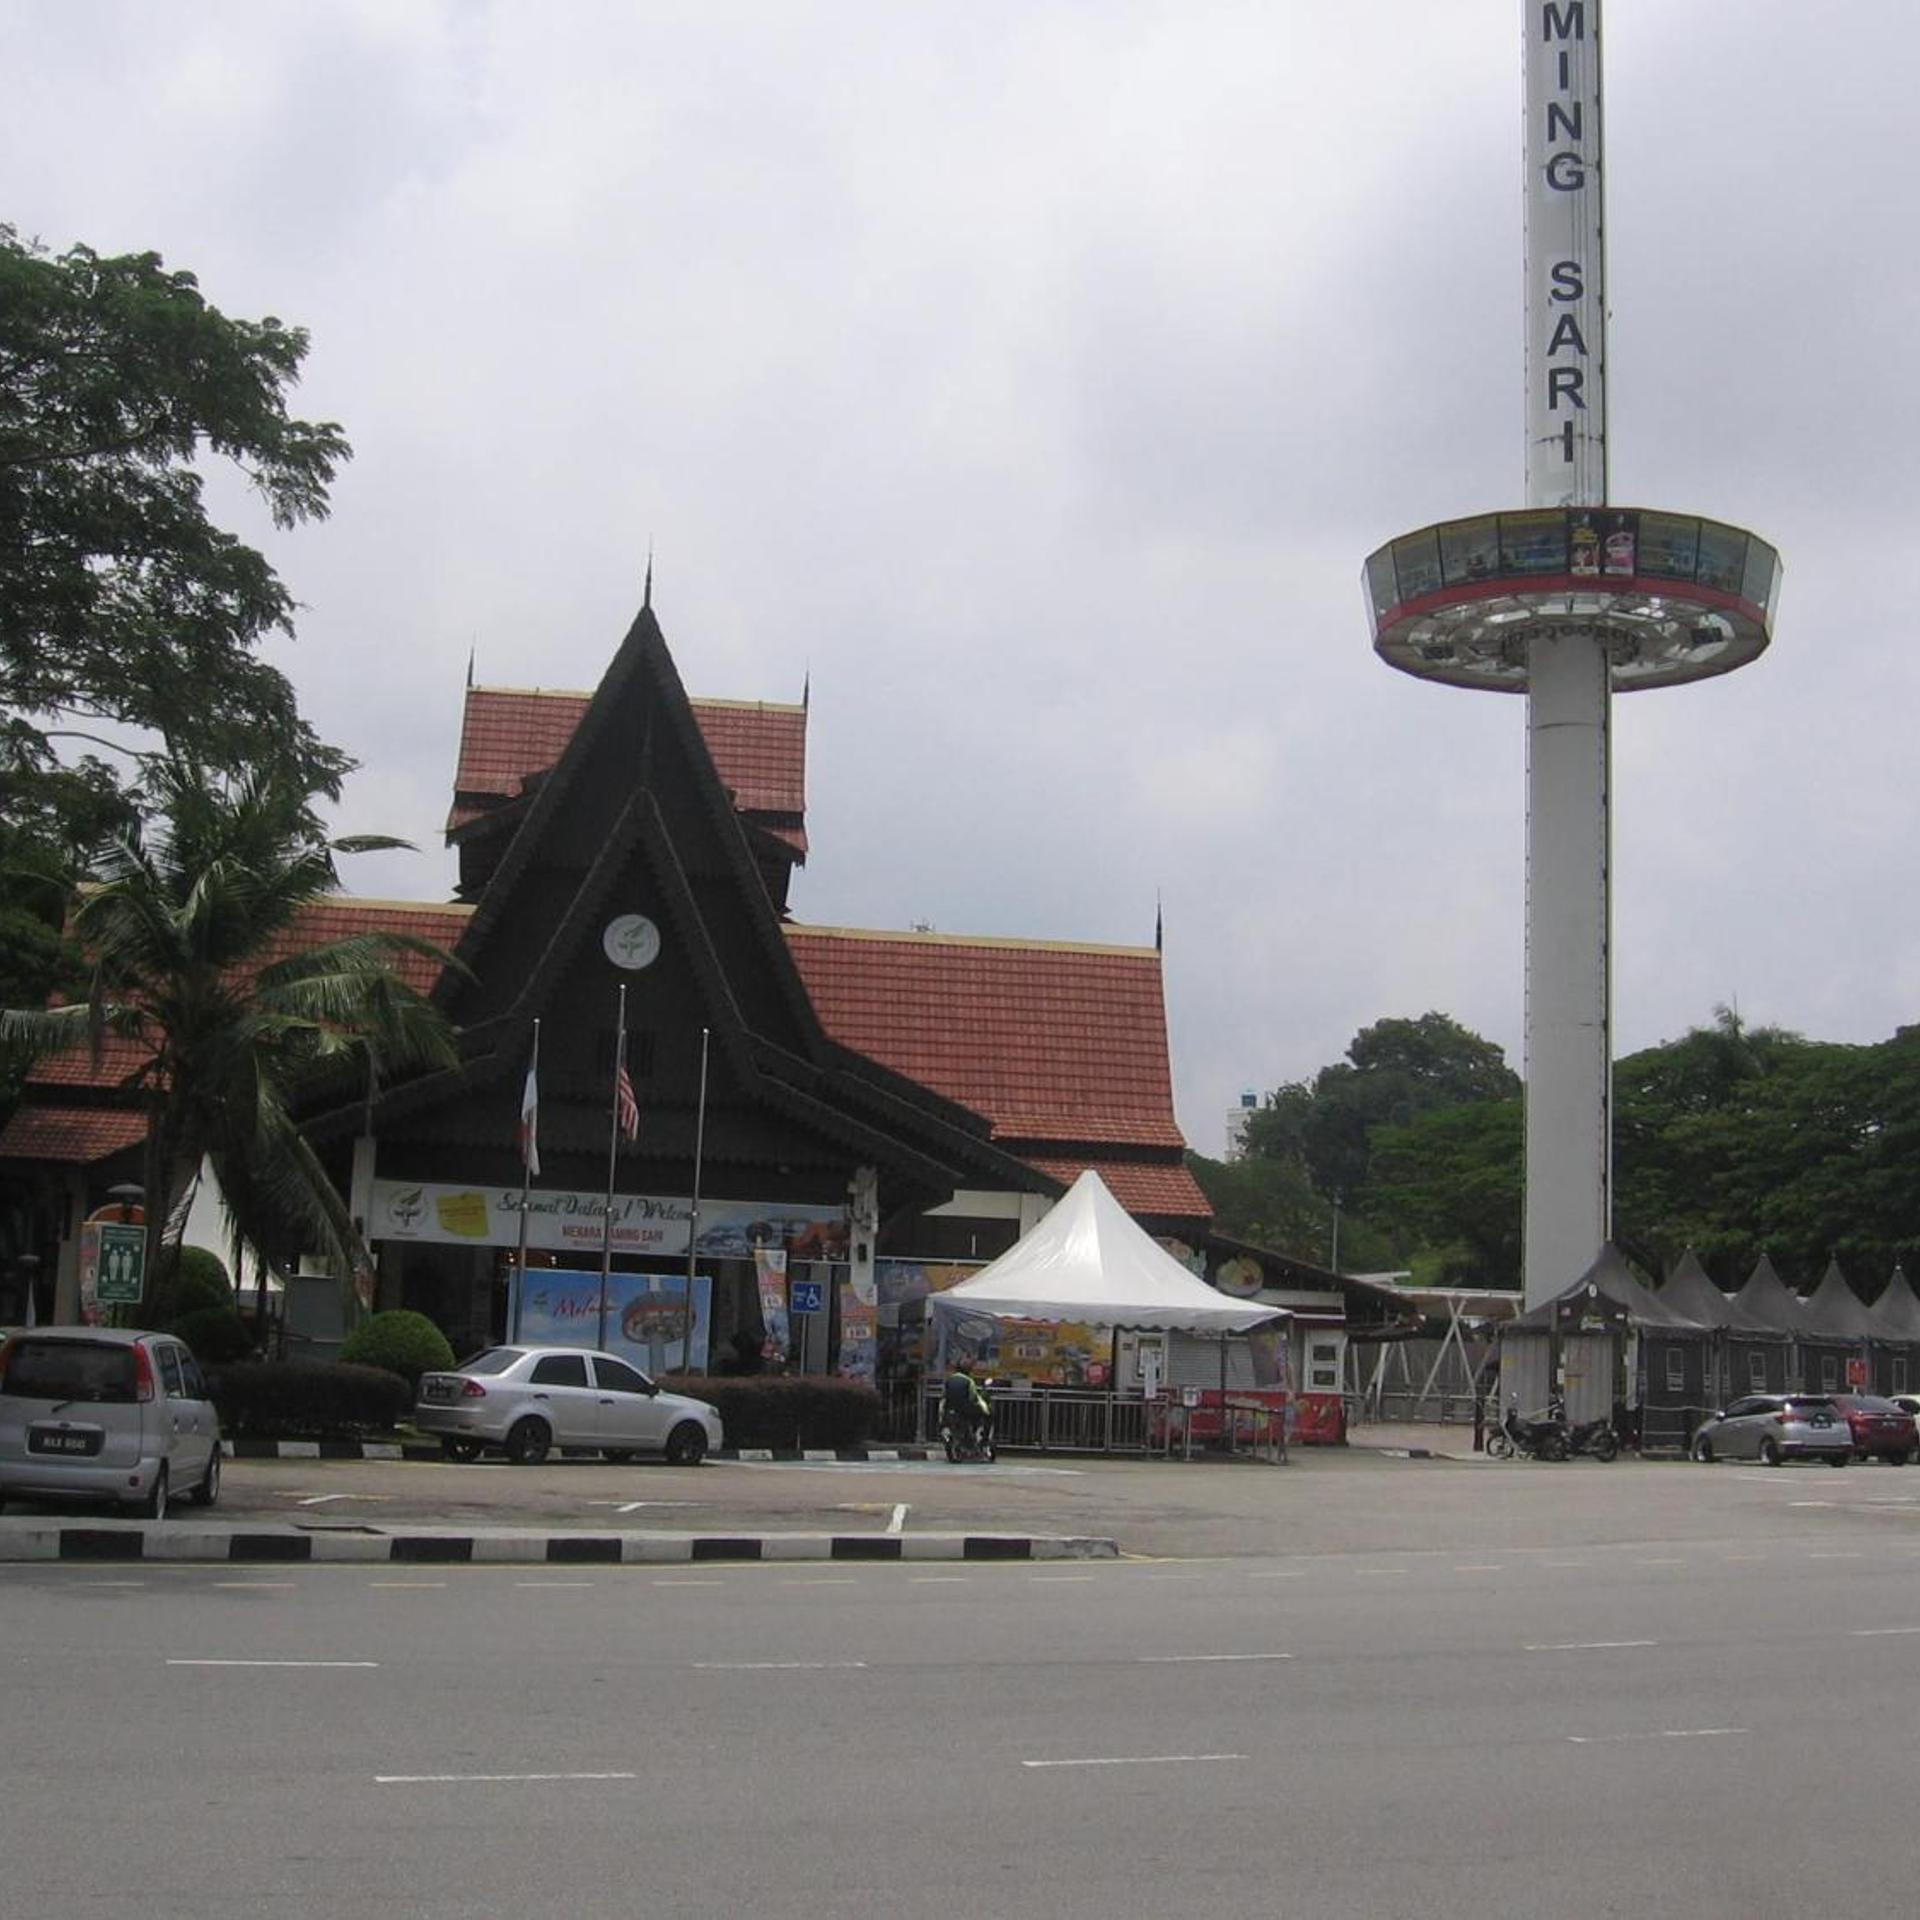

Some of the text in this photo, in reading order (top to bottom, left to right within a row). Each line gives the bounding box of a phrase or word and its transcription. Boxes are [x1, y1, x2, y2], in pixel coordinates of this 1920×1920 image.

[1543, 1, 1588, 464] MING SARI
[637, 1199, 699, 1221] Welcom
[606, 1227, 640, 1242] AMING
